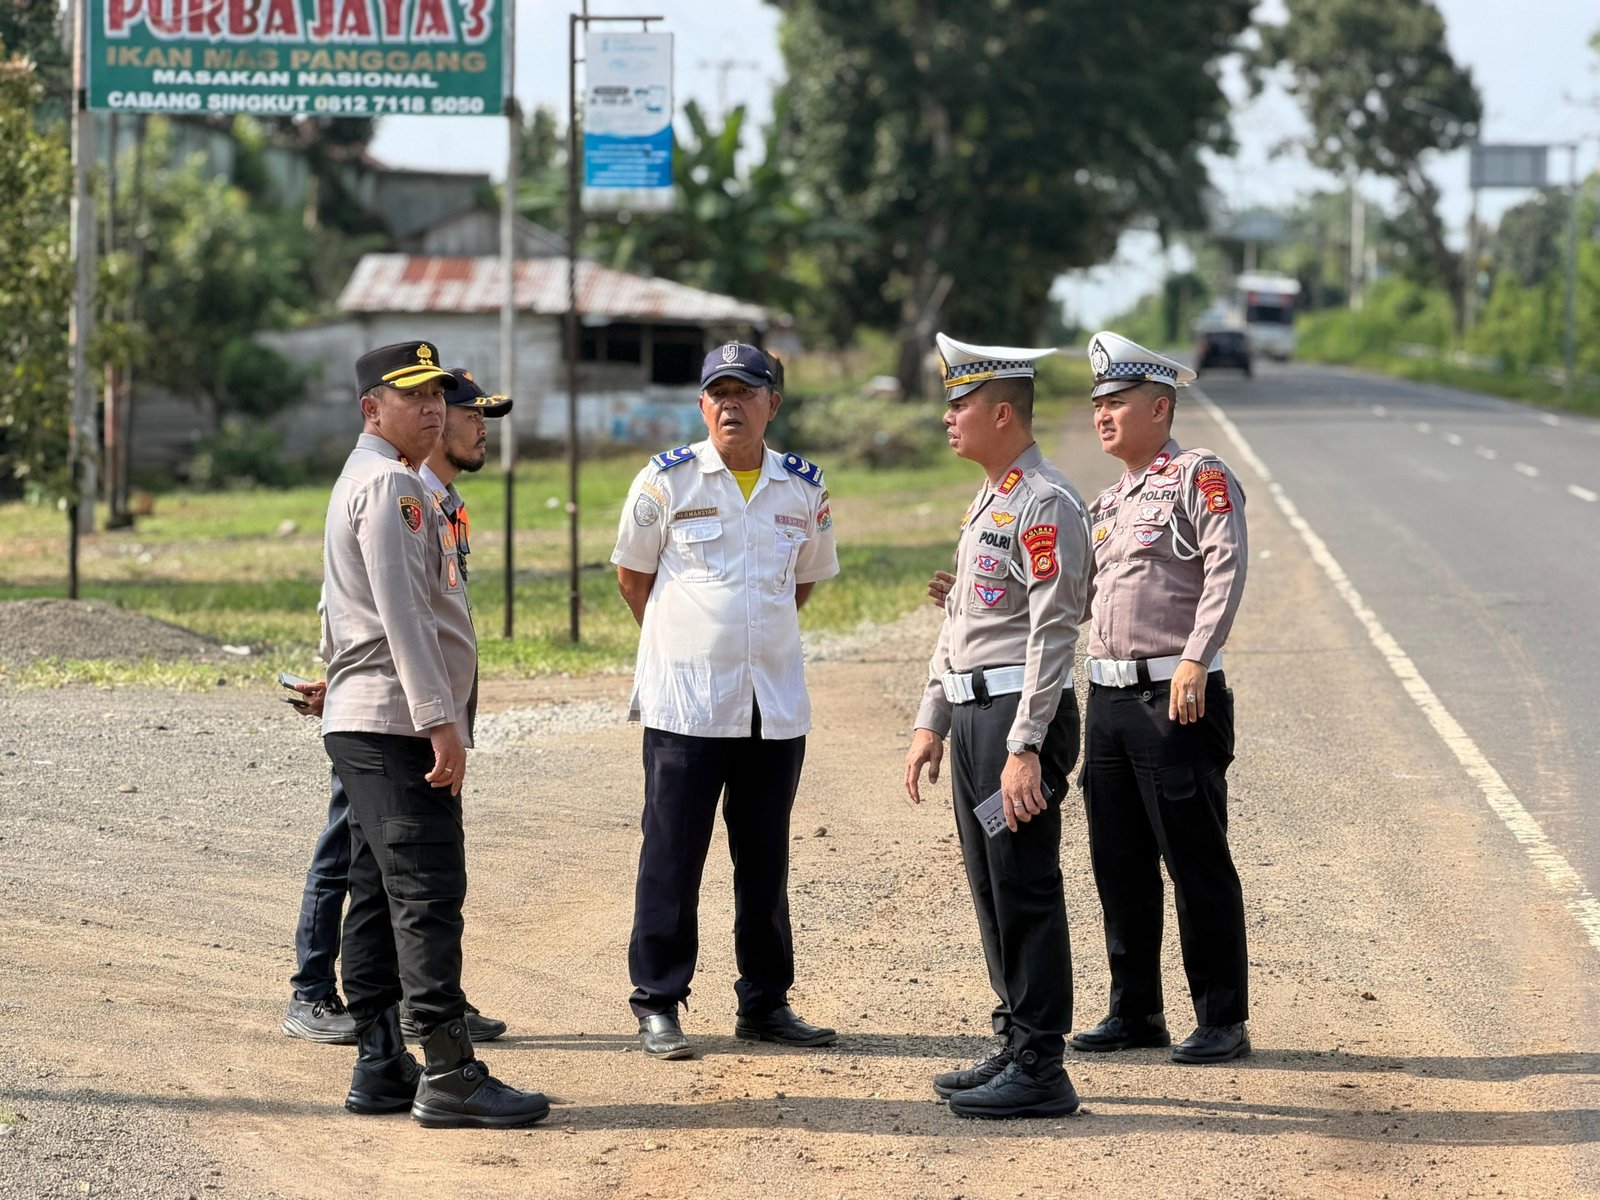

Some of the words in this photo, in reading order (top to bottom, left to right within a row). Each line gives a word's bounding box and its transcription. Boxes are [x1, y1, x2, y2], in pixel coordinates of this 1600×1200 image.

[104, 0, 303, 44] PURBA
[307, 0, 457, 44] JAYA
[459, 0, 494, 46] 3
[106, 46, 192, 68] IKAN
[203, 48, 279, 69] MAS
[290, 50, 487, 72] PANGGANG
[153, 70, 290, 87] MASAKAN
[298, 72, 438, 88] NASIONAL
[107, 91, 201, 109] CABANG
[207, 93, 310, 111] SINGKUT
[314, 95, 367, 113] 0812
[372, 96, 425, 113] 7118
[431, 97, 485, 114] 5050
[1139, 490, 1176, 502] POLRI
[978, 531, 1012, 550] POLRI
